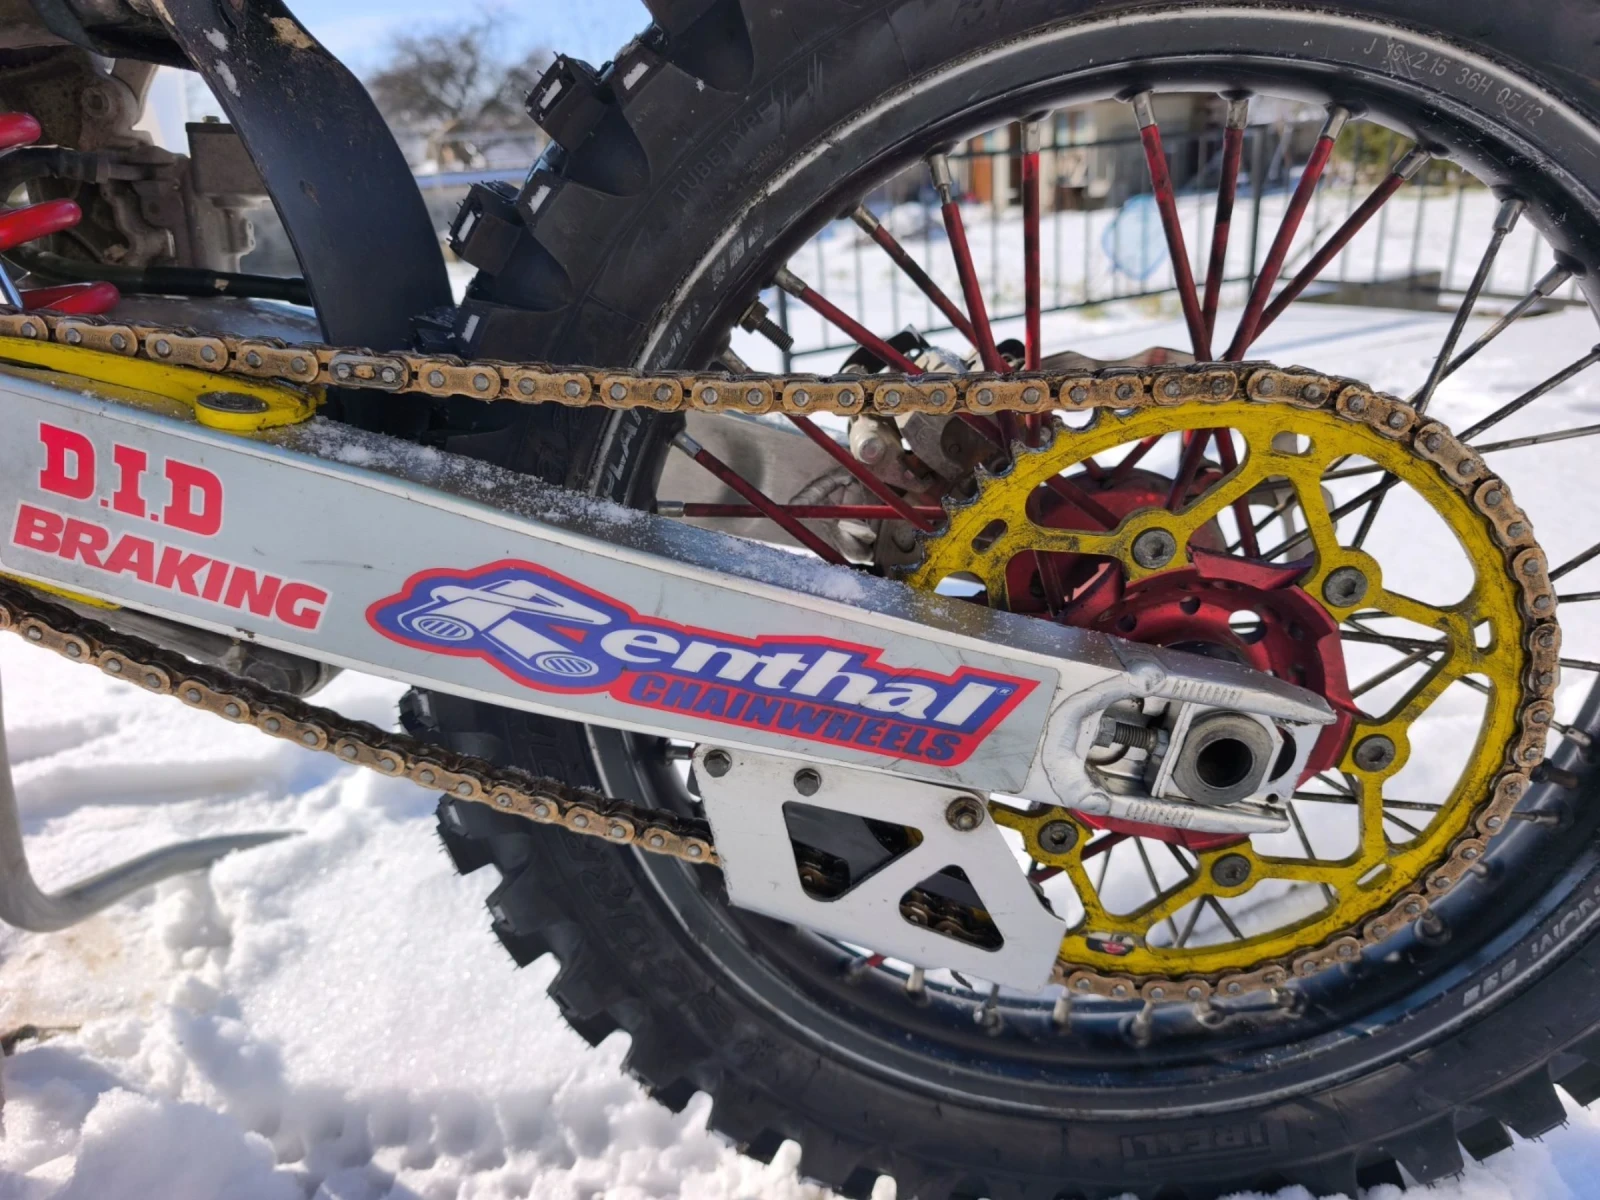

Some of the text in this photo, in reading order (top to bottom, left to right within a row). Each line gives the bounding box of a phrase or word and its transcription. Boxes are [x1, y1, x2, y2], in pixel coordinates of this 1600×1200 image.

[1455, 67, 1494, 97] 36H
[1495, 86, 1545, 127] 05/12
[39, 421, 223, 537] D.I.D
[13, 503, 329, 631] BRAKING
[396, 578, 1003, 727] Renthal
[628, 671, 963, 762] CHAINWHEELS
